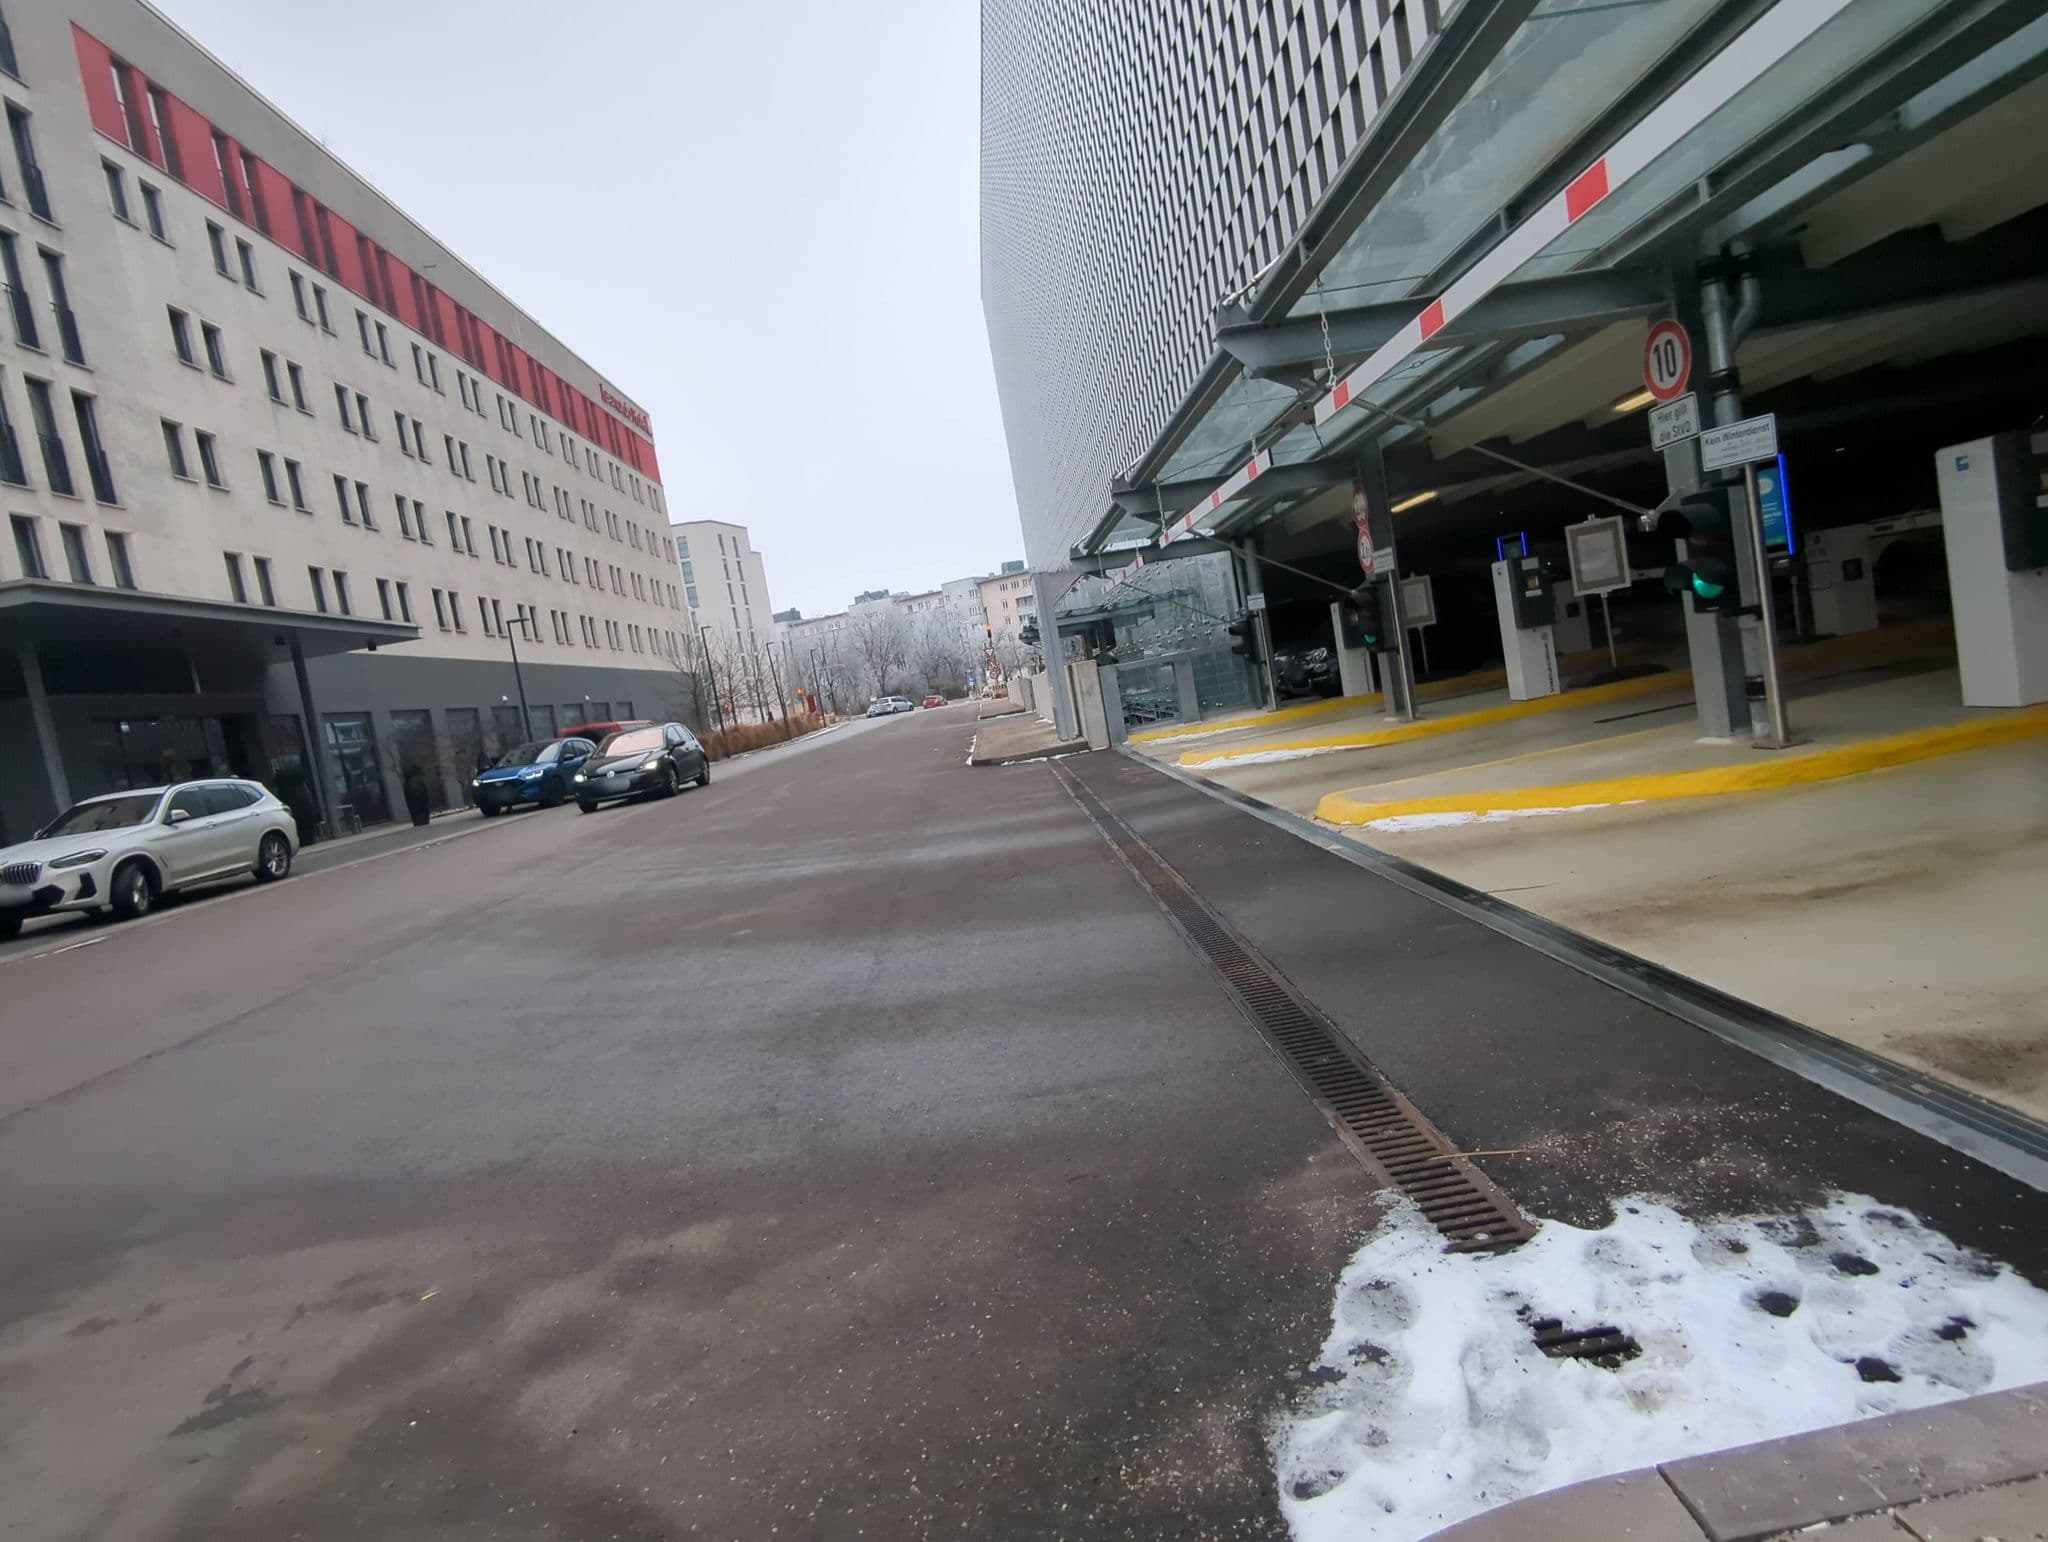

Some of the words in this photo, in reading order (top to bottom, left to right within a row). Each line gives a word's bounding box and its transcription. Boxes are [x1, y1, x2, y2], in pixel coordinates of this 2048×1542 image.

[1653, 338, 1677, 382] 10
[1656, 411, 1674, 424] Hier
[1673, 403, 1687, 421] gilt
[1672, 421, 1691, 438] StVO
[1704, 436, 1722, 446] Kein
[1722, 423, 1770, 442] Winterdienst
